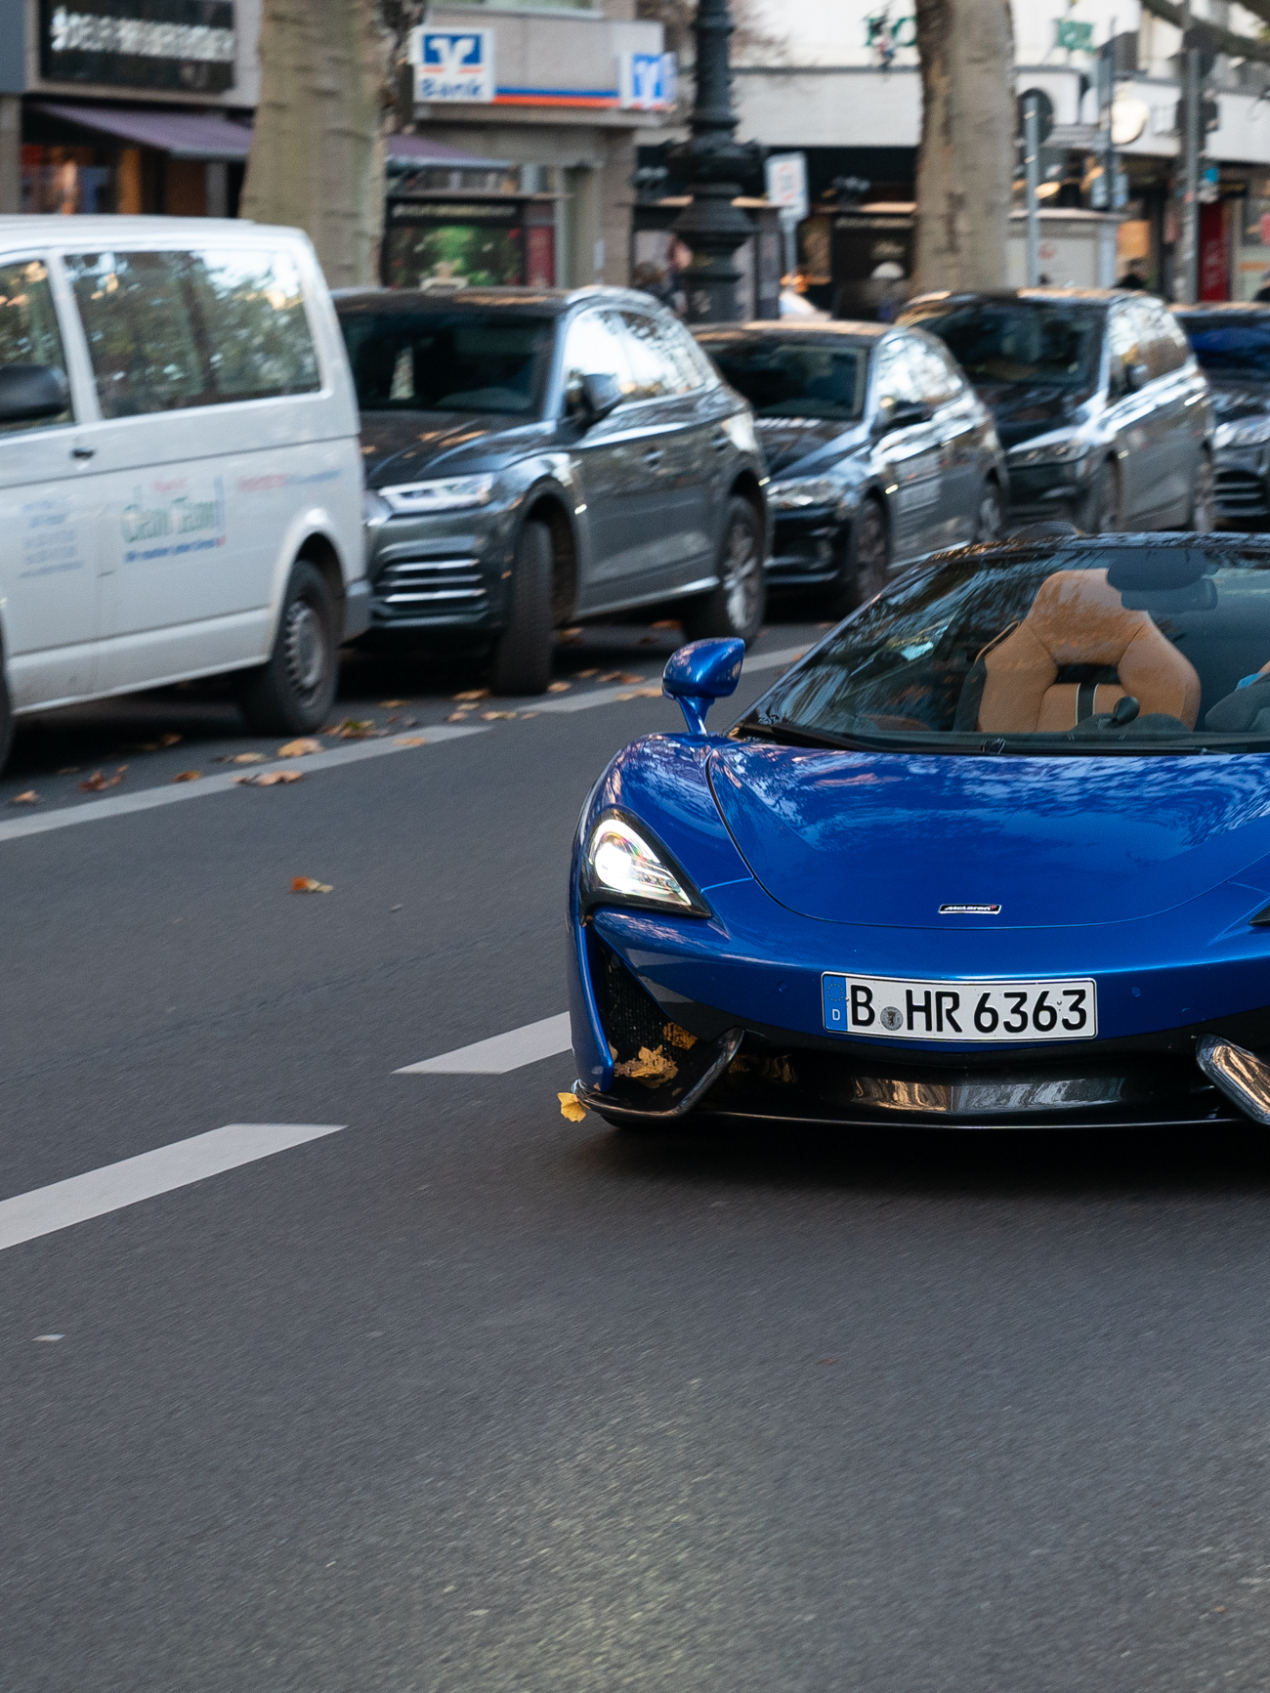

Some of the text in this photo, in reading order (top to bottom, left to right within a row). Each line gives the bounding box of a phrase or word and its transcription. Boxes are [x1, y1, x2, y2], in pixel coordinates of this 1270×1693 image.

[420, 78, 482, 97] Bank
[832, 1008, 841, 1021] D
[850, 984, 876, 1027] B
[905, 989, 963, 1033] HR
[973, 989, 1087, 1034] 6363
